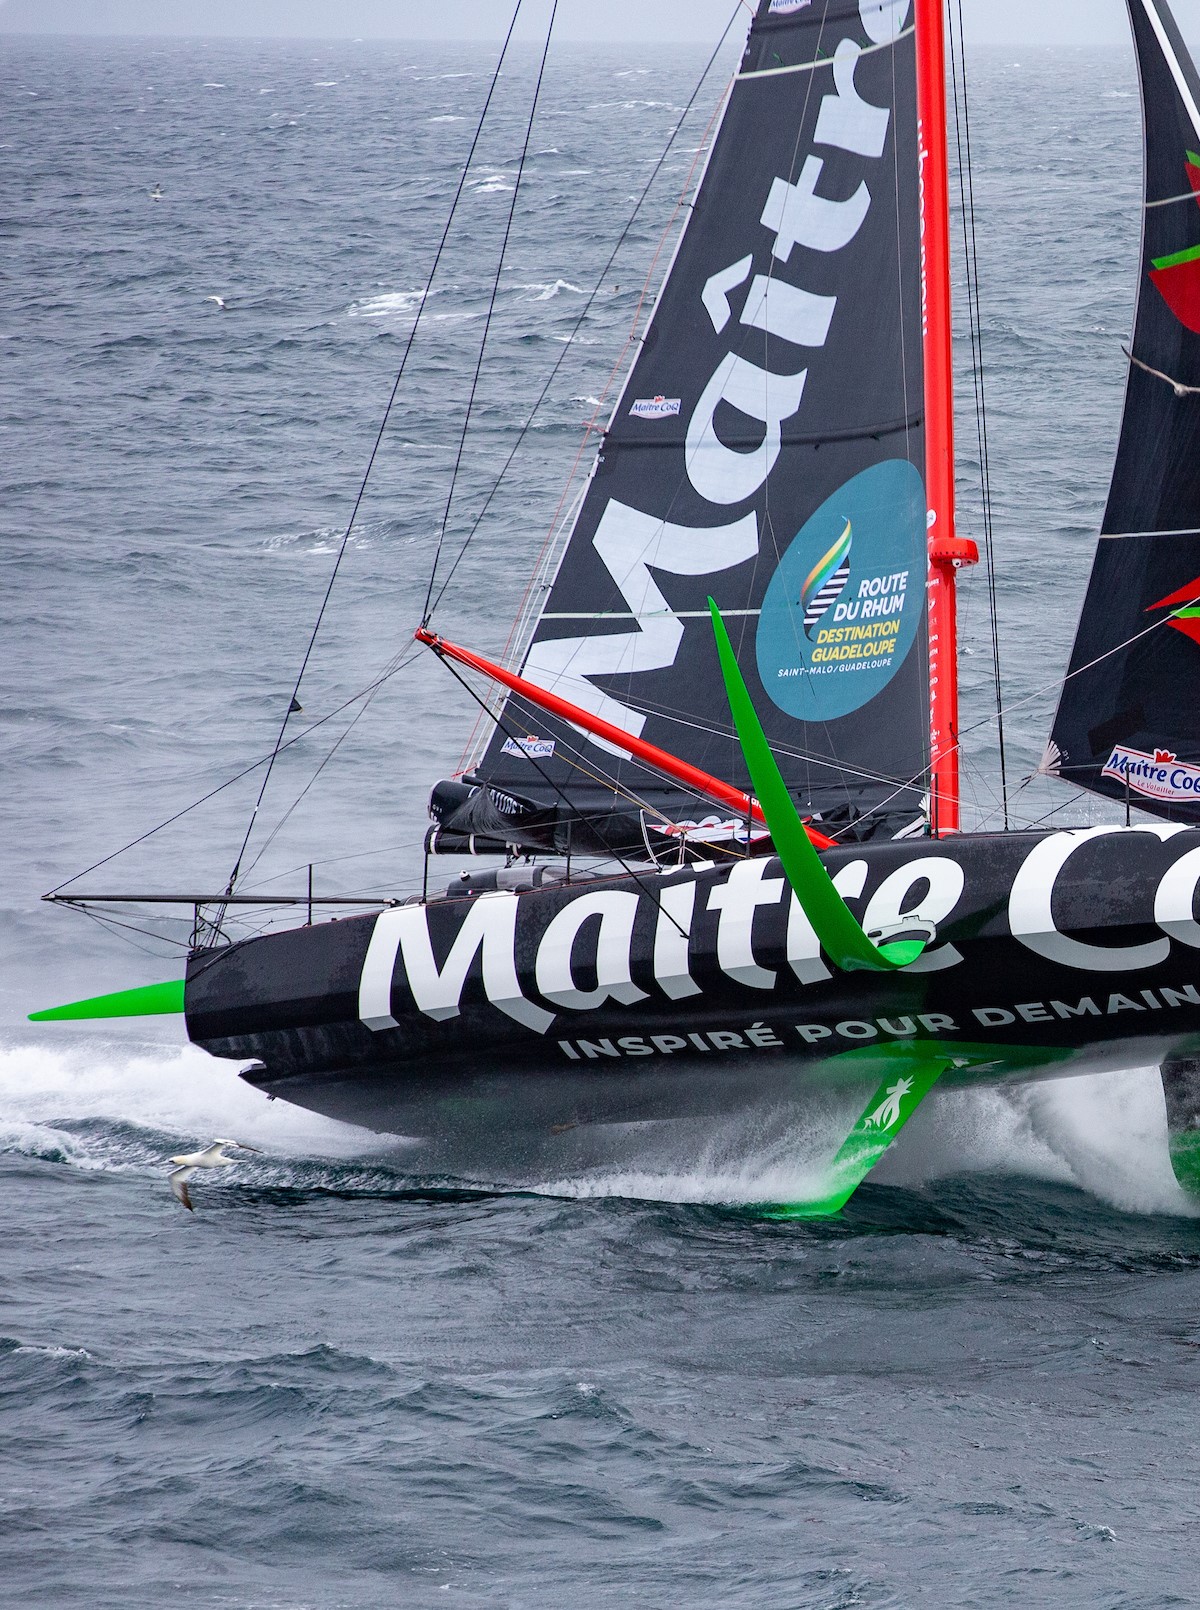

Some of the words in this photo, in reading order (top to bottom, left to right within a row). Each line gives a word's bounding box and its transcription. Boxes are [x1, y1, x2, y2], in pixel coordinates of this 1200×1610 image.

[660, 402, 679, 411] CoQ
[858, 571, 909, 598] ROUTE
[833, 601, 860, 622] DU
[860, 593, 905, 619] RHUM
[816, 619, 900, 645] DESTINATION
[811, 638, 896, 663] GUADELOUPE
[533, 743, 553, 752] CoQ
[1107, 753, 1166, 782] Maître
[358, 856, 965, 1034] Maître
[557, 1022, 785, 1060] INSPIRÉ
[796, 1012, 961, 1043] POUR
